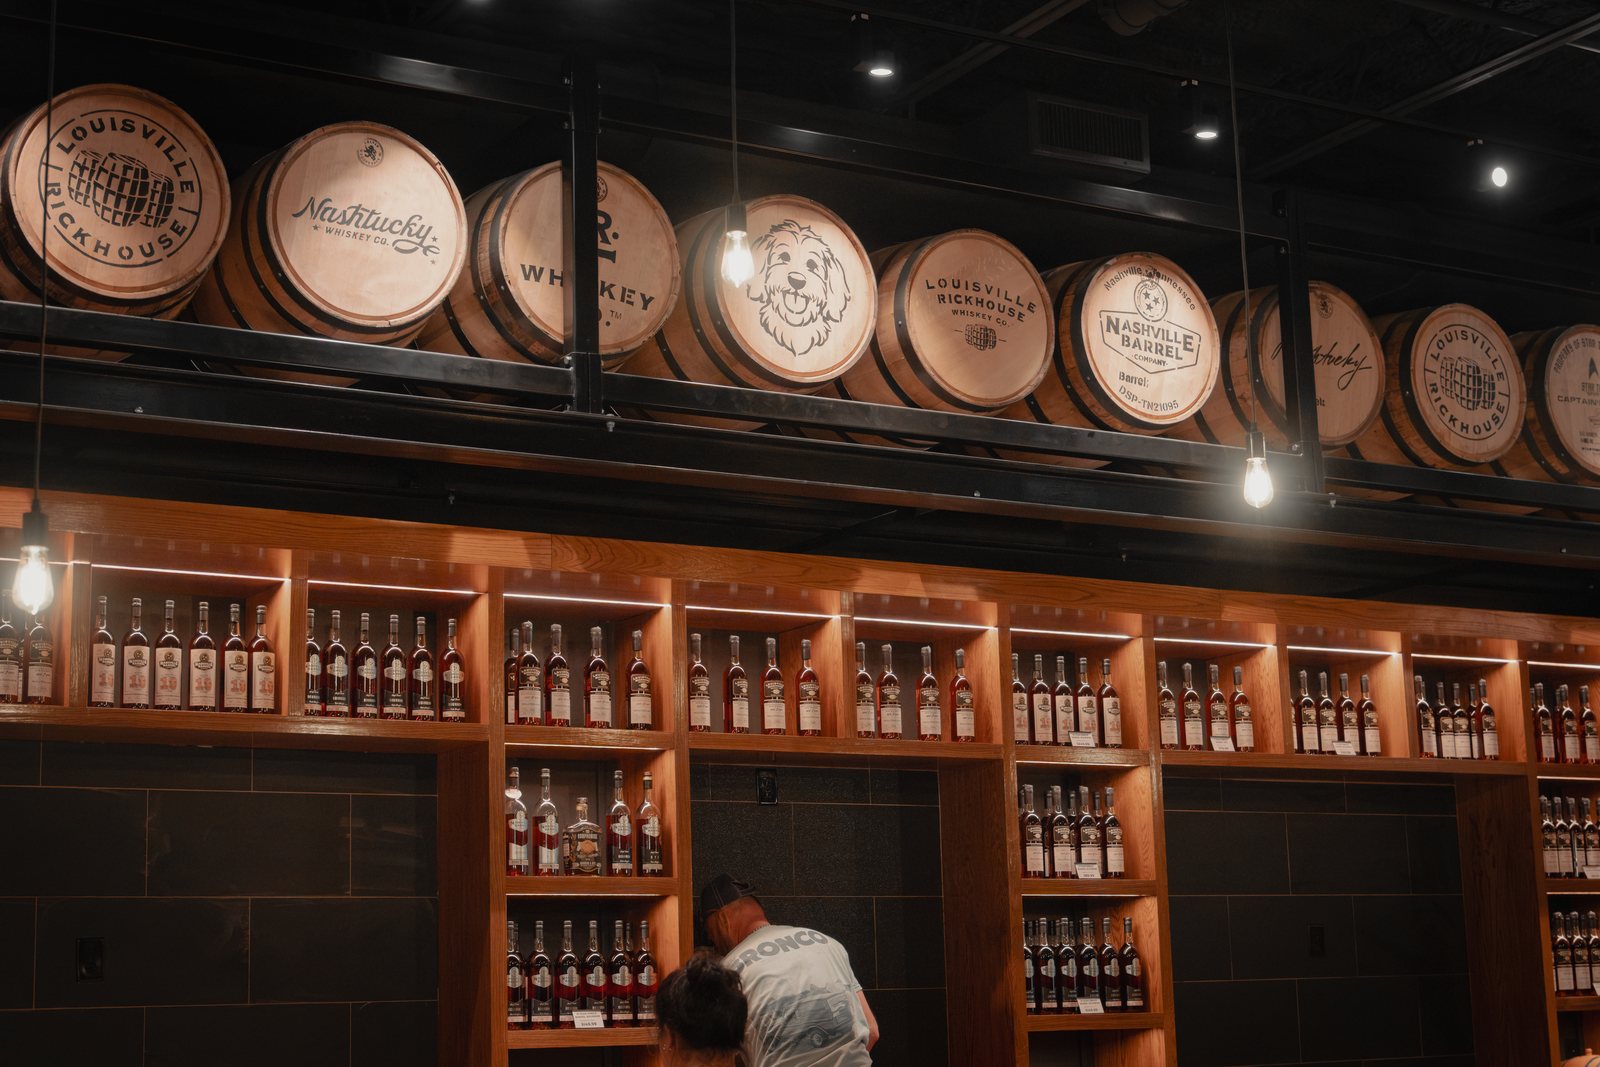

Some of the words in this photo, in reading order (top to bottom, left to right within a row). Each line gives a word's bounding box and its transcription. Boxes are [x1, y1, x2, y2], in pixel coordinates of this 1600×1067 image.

[56, 116, 195, 193] LOUISVILLE
[47, 181, 188, 260] RICKHOUSE
[292, 196, 440, 256] Nashtucky
[325, 226, 371, 242] WHISKEY
[374, 236, 390, 246] CO.
[520, 263, 655, 311] WHKEY
[925, 278, 1037, 314] LOUISVILLE
[937, 293, 1026, 323] RICKHOUSE
[951, 308, 992, 321] WHISKEY
[1105, 315, 1194, 352] NASHVILLE
[1120, 334, 1184, 361] BARREL
[1430, 329, 1505, 382] LOUISVILLE
[1429, 382, 1505, 435] RICKHOUSE
